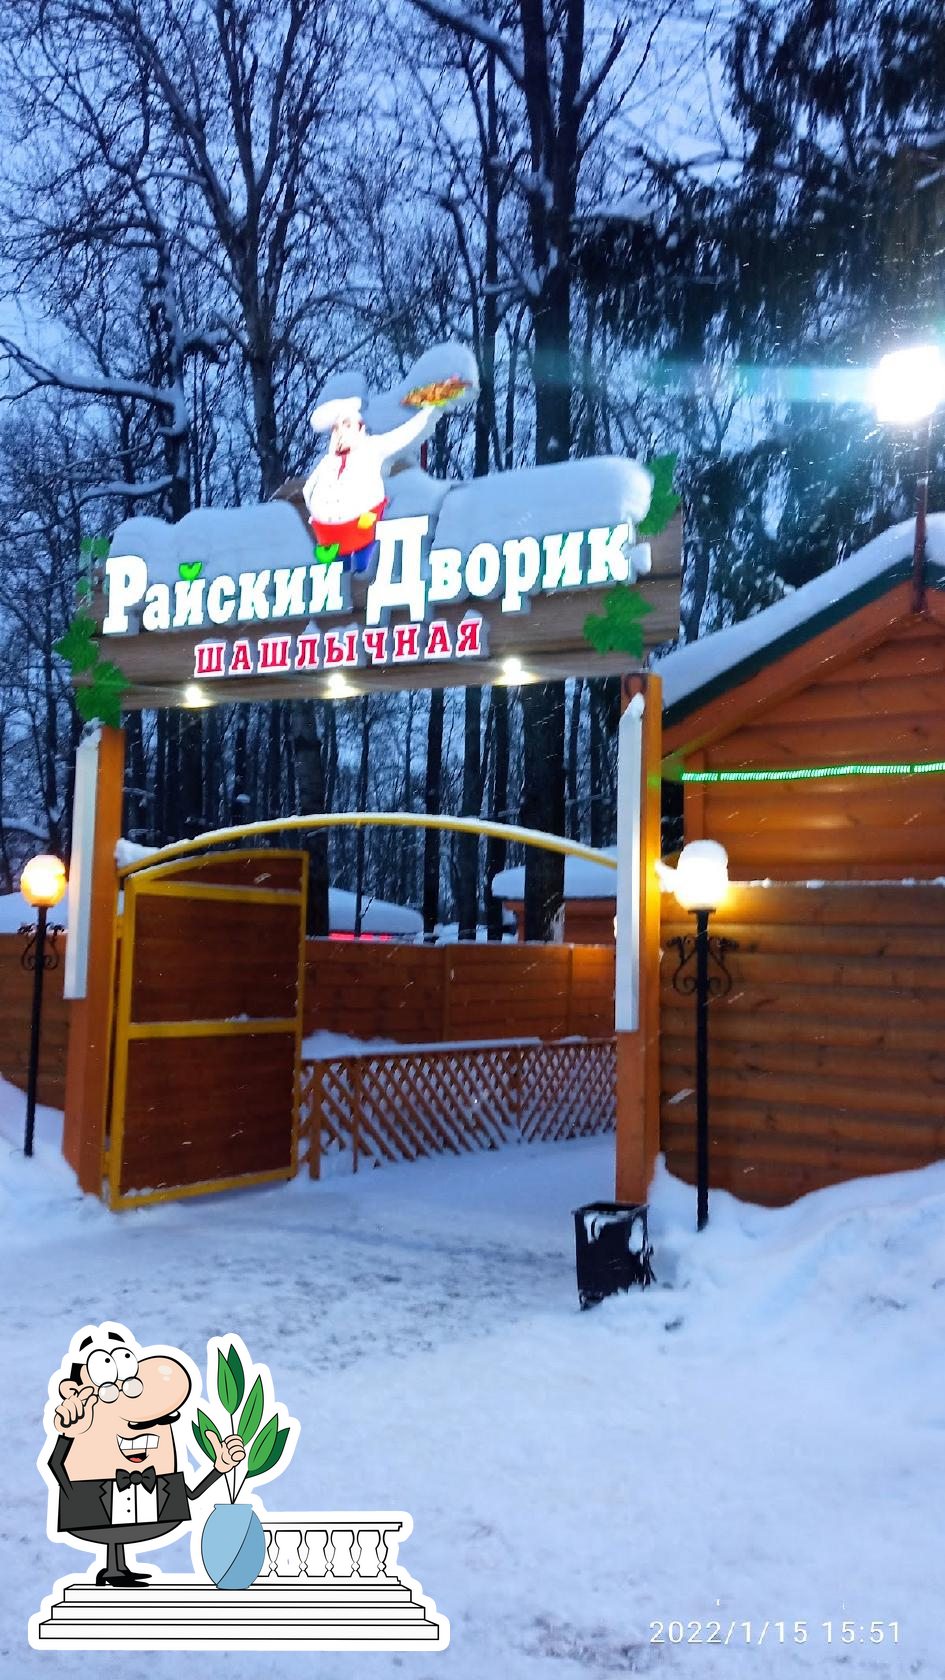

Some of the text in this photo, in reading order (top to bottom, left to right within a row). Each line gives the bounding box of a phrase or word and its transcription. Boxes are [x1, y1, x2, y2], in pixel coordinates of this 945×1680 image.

[103, 515, 632, 634] Райский Дворик
[194, 617, 483, 677] ШАШЛЫЧНАЯ
